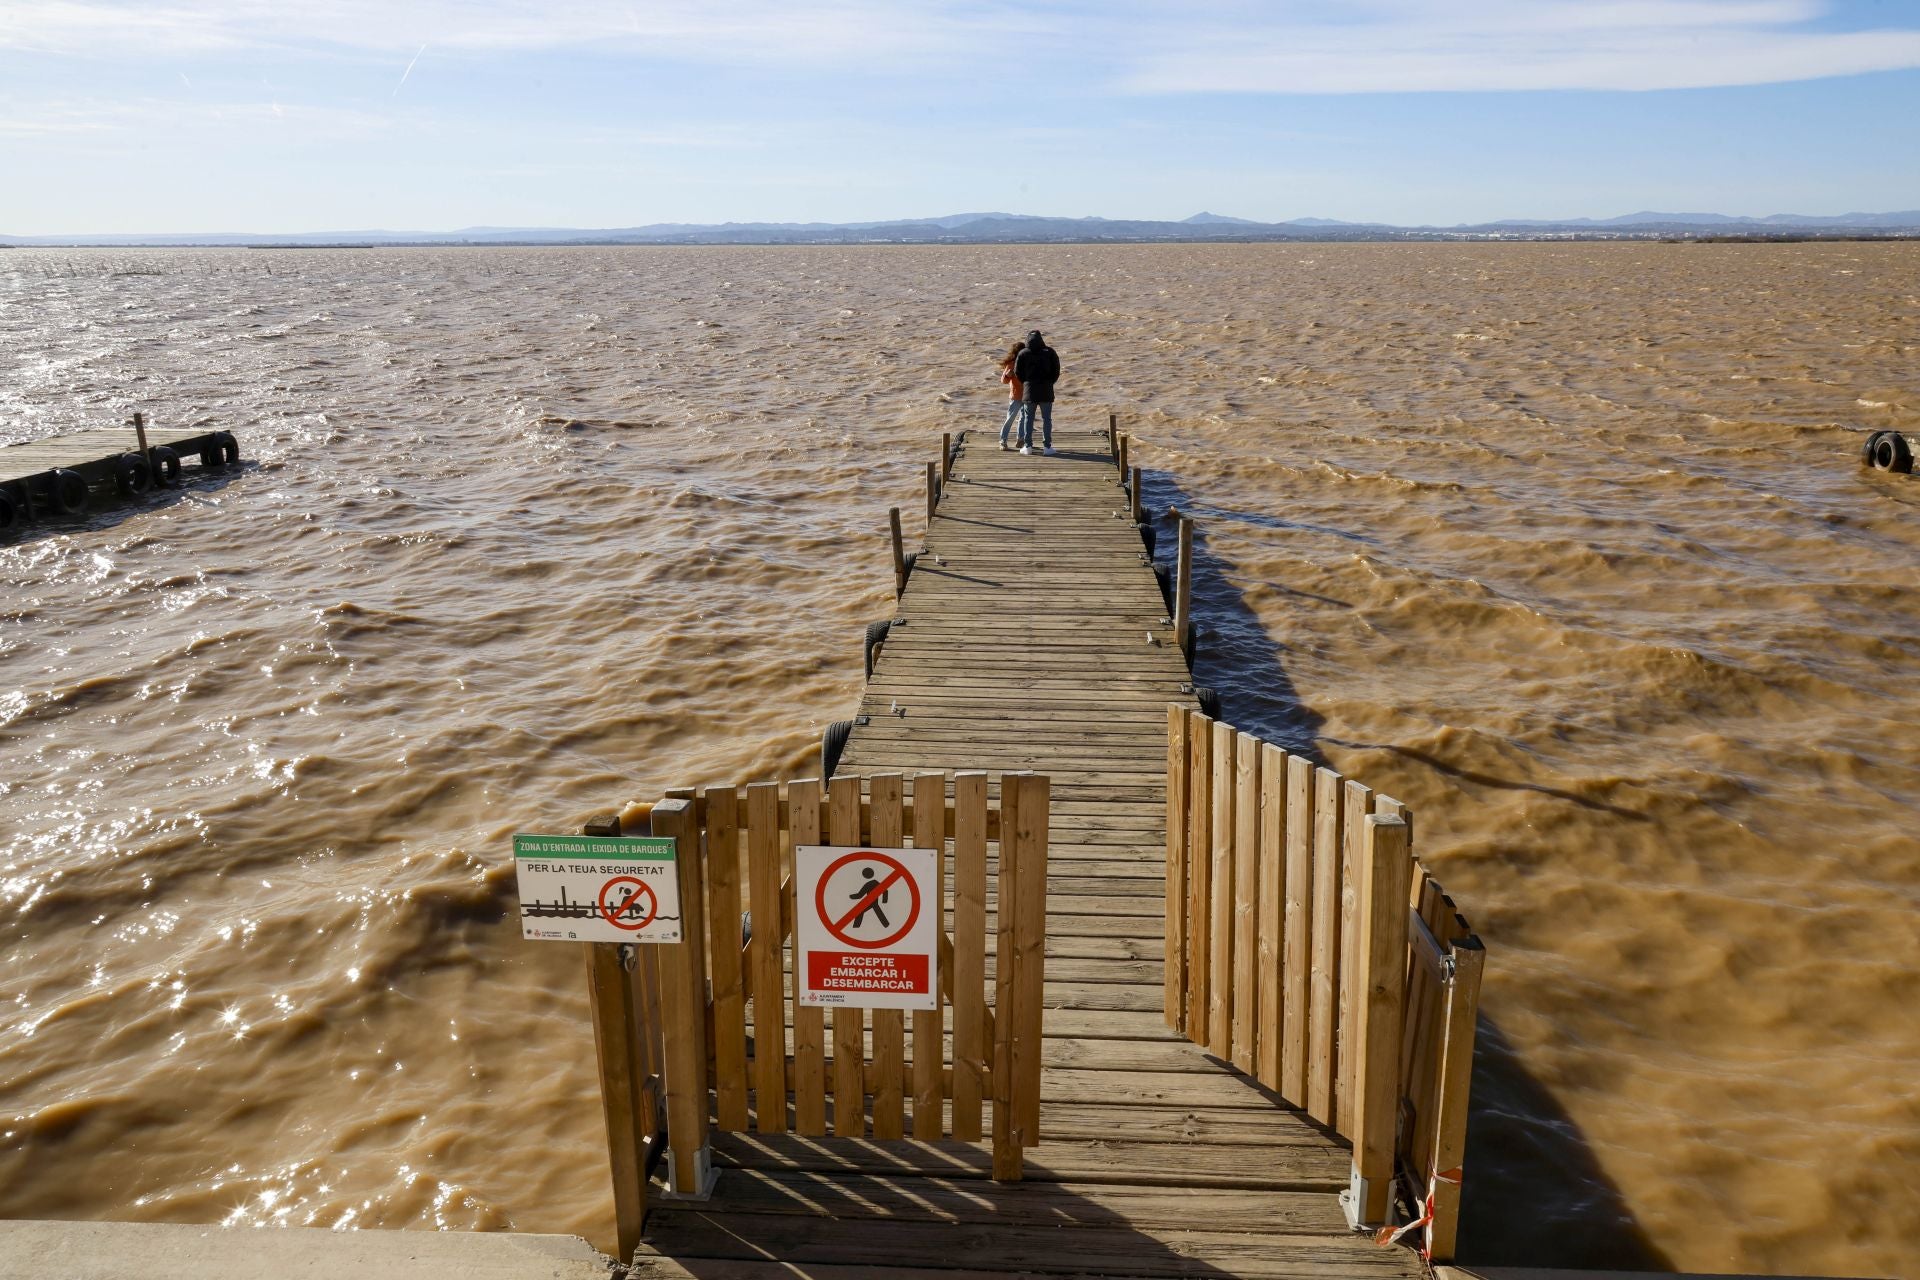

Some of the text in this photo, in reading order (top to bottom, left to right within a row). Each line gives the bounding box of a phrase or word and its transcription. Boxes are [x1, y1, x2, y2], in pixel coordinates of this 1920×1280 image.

[520, 842, 541, 852] ZONA
[543, 842, 586, 853] D'ENTRADA
[592, 843, 618, 854] EIXIDA
[620, 844, 630, 854] DE
[631, 845, 668, 855] BARQUES
[528, 863, 664, 875] PER LA TEUA SEGURETAT
[842, 956, 895, 967] EXCEPTE
[830, 967, 907, 978] EMBARCAR I
[823, 978, 914, 990] DESEMBARCAR
